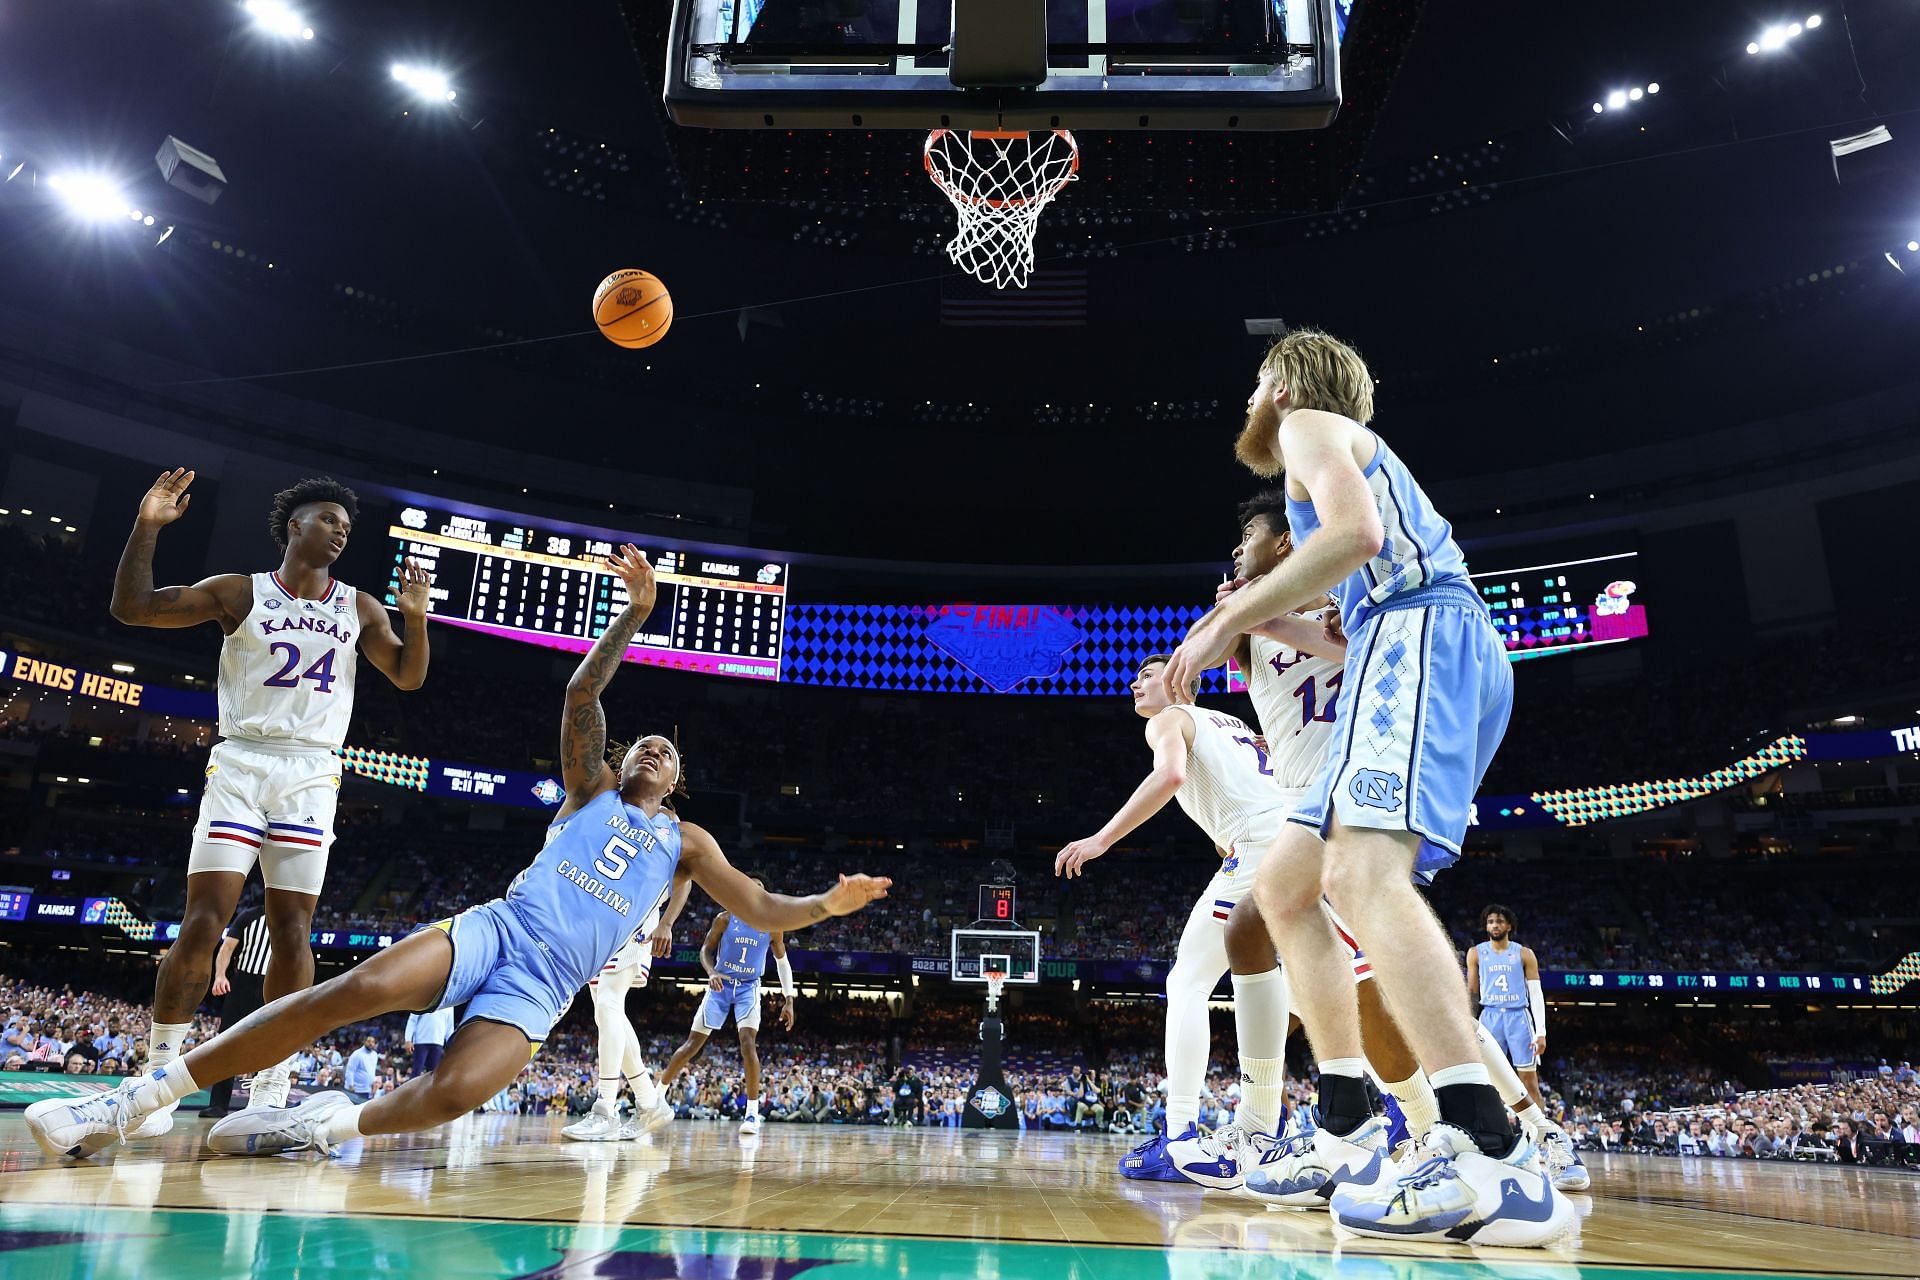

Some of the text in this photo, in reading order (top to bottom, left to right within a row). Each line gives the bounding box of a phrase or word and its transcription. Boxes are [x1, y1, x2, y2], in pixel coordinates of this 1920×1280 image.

[451, 516, 486, 532] NORTH
[441, 525, 492, 544] CAROLINA
[547, 537, 571, 556] 38
[701, 562, 739, 576] KANSAS
[596, 602, 608, 611] 24
[595, 615, 606, 624] 30
[260, 617, 351, 644] KANSAS
[1576, 623, 1584, 635] 7
[263, 641, 337, 694] 24
[12, 655, 144, 707] ENDS HERE
[452, 777, 494, 796] 9:11 PM
[493, 775, 506, 784] 4TH
[606, 815, 657, 853] NORTH
[594, 834, 640, 881] 5
[557, 859, 633, 917] CAROLINA
[38, 904, 76, 916] KANSAS
[997, 899, 1009, 918] 8
[321, 933, 335, 945] 37
[349, 935, 374, 946] 3PT%
[735, 937, 758, 948] NORTH
[739, 947, 748, 964] 1
[724, 961, 755, 974] CAROLINA
[912, 960, 934, 971] 2022
[1488, 964, 1512, 973] NORTH
[1494, 974, 1509, 992] 4
[1565, 975, 1585, 985] FG%
[1618, 975, 1645, 986] 3PT%
[1677, 975, 1698, 986] FT%
[1730, 976, 1748, 987] AST
[1779, 976, 1800, 988] REB
[1832, 977, 1846, 989] TO
[1486, 993, 1520, 1003] CAROLINA
